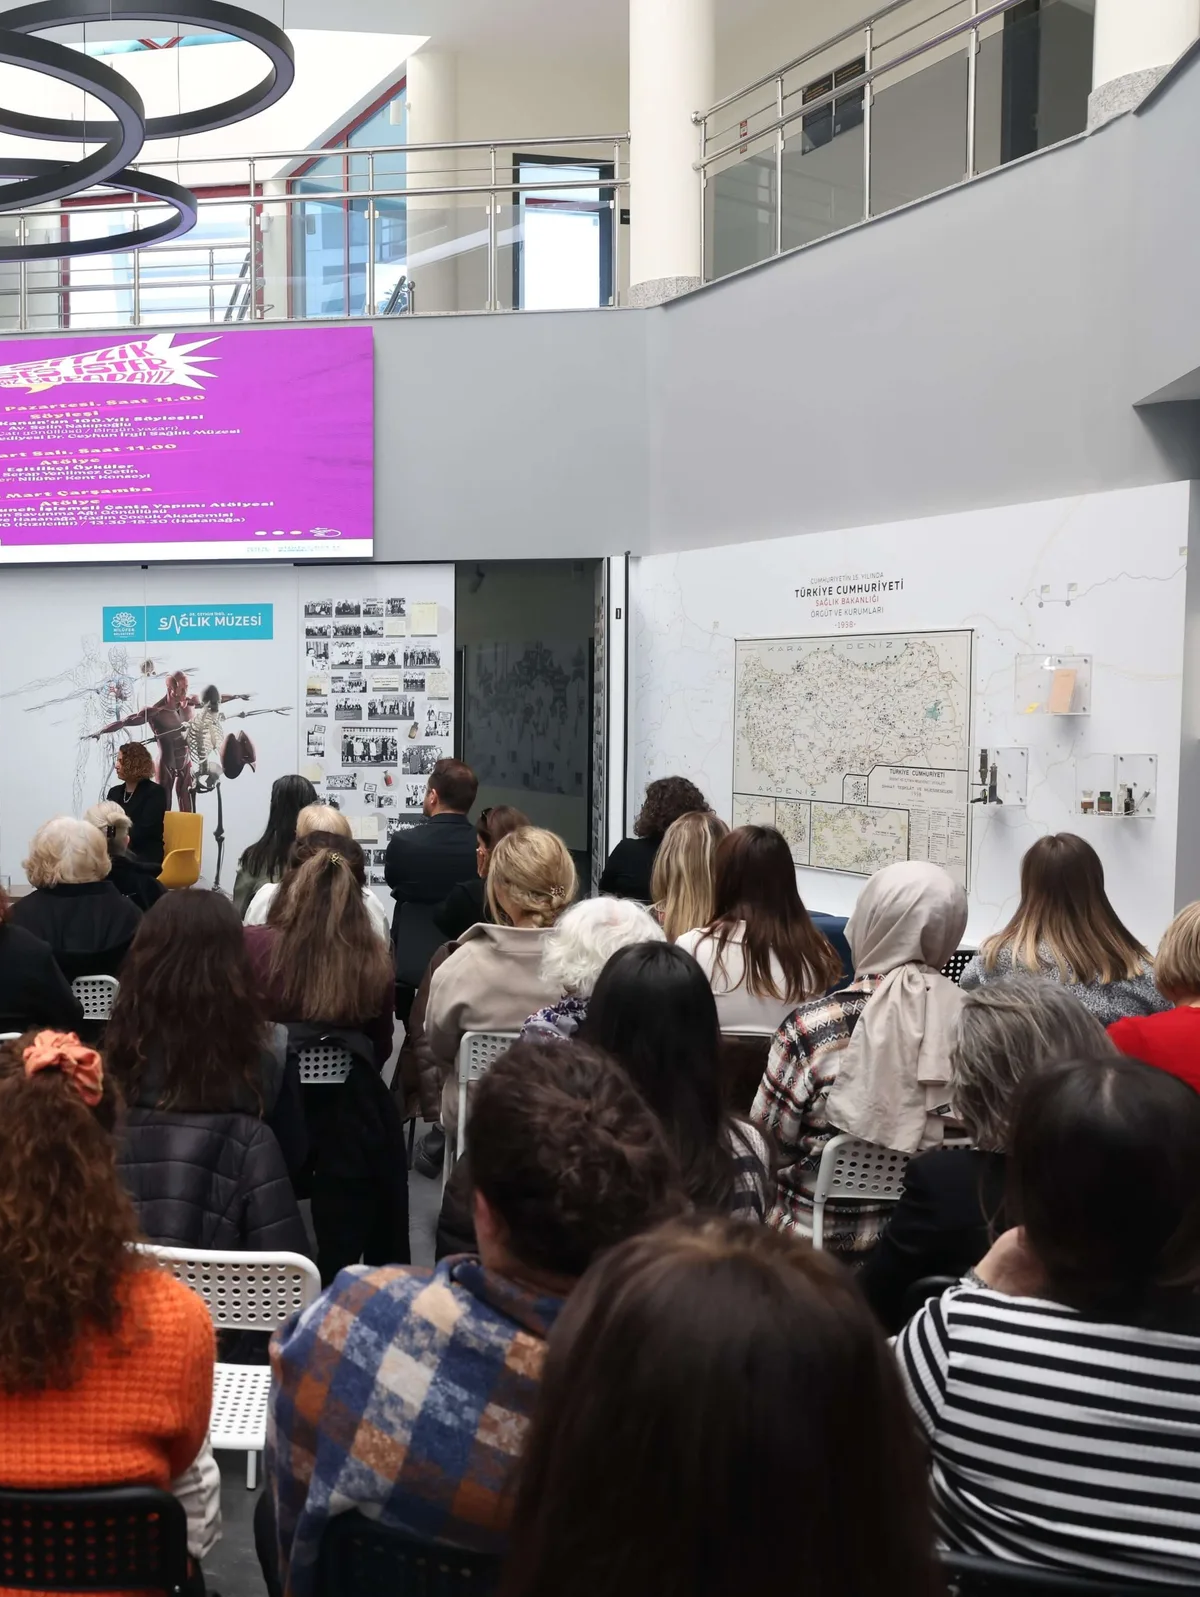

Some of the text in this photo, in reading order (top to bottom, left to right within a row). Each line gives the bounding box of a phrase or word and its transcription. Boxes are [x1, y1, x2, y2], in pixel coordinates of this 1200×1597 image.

[105, 398, 149, 406] Saat
[153, 394, 205, 403] 11.00
[78, 446, 121, 454] Saat
[125, 443, 178, 451] 11.00
[5, 491, 53, 499] Mart
[794, 578, 904, 598] TÜRKİYE CUMHURİYETİ
[815, 597, 839, 607] SAĞLIK
[844, 606, 884, 616] KURUMLARI
[158, 612, 262, 635] SAĞLIK MÜZESİ
